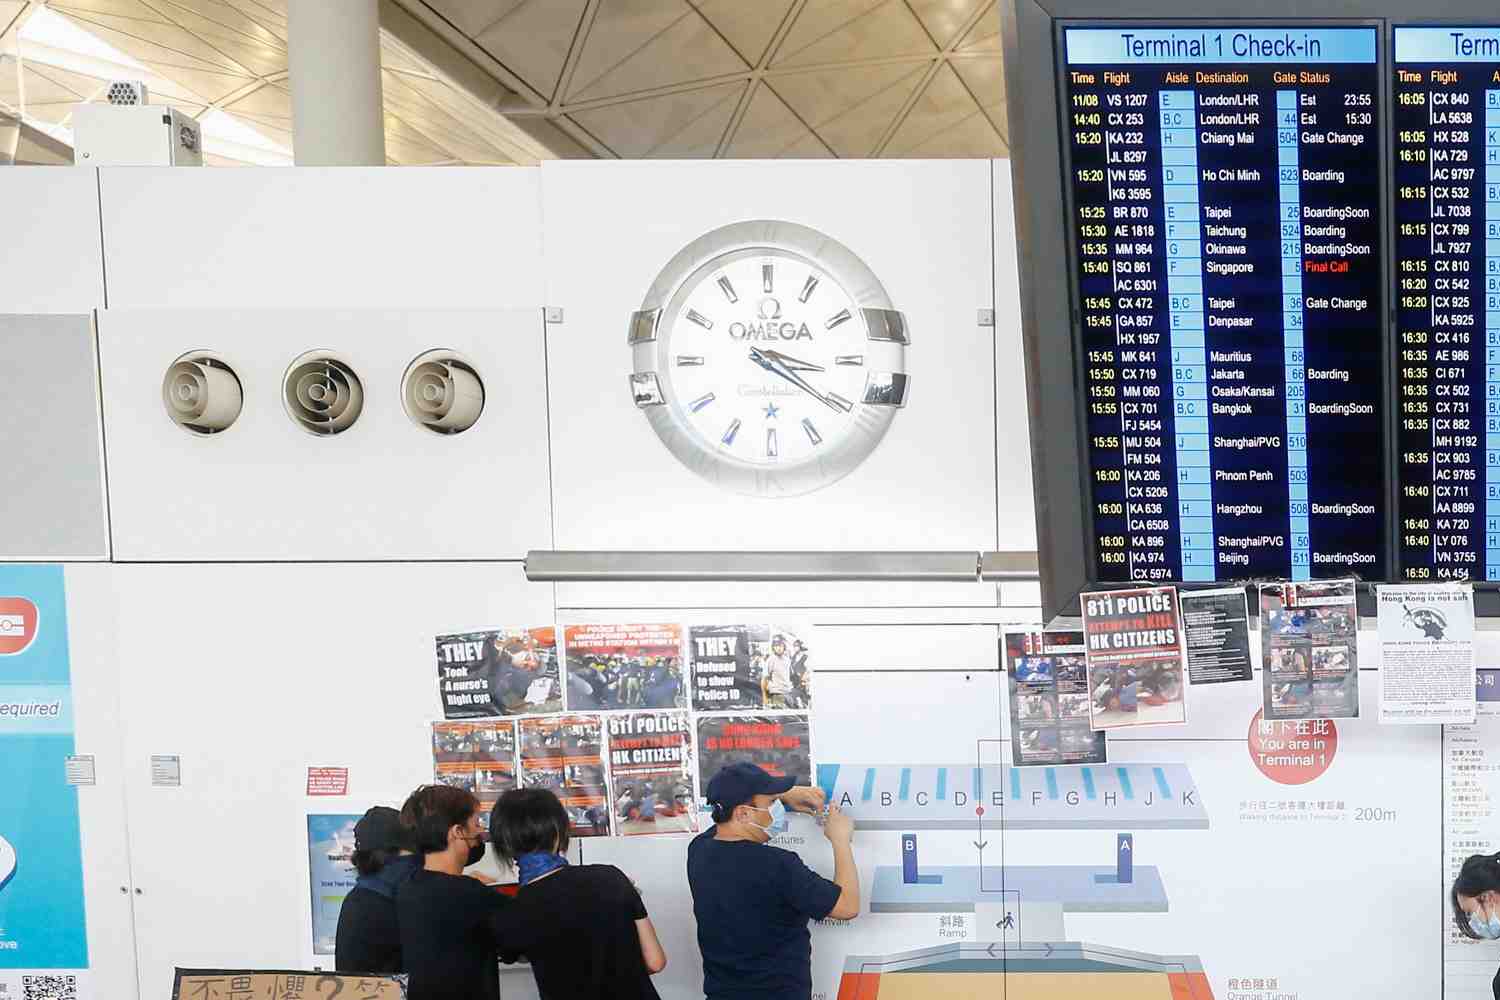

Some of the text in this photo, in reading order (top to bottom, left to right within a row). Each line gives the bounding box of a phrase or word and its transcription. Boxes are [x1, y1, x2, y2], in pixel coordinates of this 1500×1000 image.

[1122, 33, 1321, 58] Terminal 1 Check-in
[1071, 72, 1330, 85] Time Flight Aisle Destination Gate Status
[1072, 94, 1371, 106] 11/08 VS 1207 E London/LHR Est 23:55
[1398, 94, 1425, 105] 16:05
[1433, 94, 1447, 104] CX
[1451, 94, 1469, 105] 840
[729, 322, 813, 341] OMEGA
[1087, 595, 1171, 616] 811 POLICE
[1090, 629, 1175, 649] HK CITIZENS
[441, 641, 484, 663] THEY
[696, 637, 738, 656] THEY
[443, 667, 469, 677] Took
[445, 681, 452, 691] A
[697, 676, 734, 686] to show
[0, 701, 60, 718] equired
[610, 719, 632, 735] 811
[1259, 739, 1325, 750] You are in
[612, 747, 688, 764] HK CITIZEN
[1258, 754, 1325, 766] Terminal 1
[840, 792, 1194, 807] A B C D E F G H J K
[1354, 808, 1396, 821] 200m
[905, 840, 914, 851] B
[1120, 840, 1131, 851] A
[939, 928, 967, 939] Ramp
[1265, 992, 1299, 1000] Tunnel
